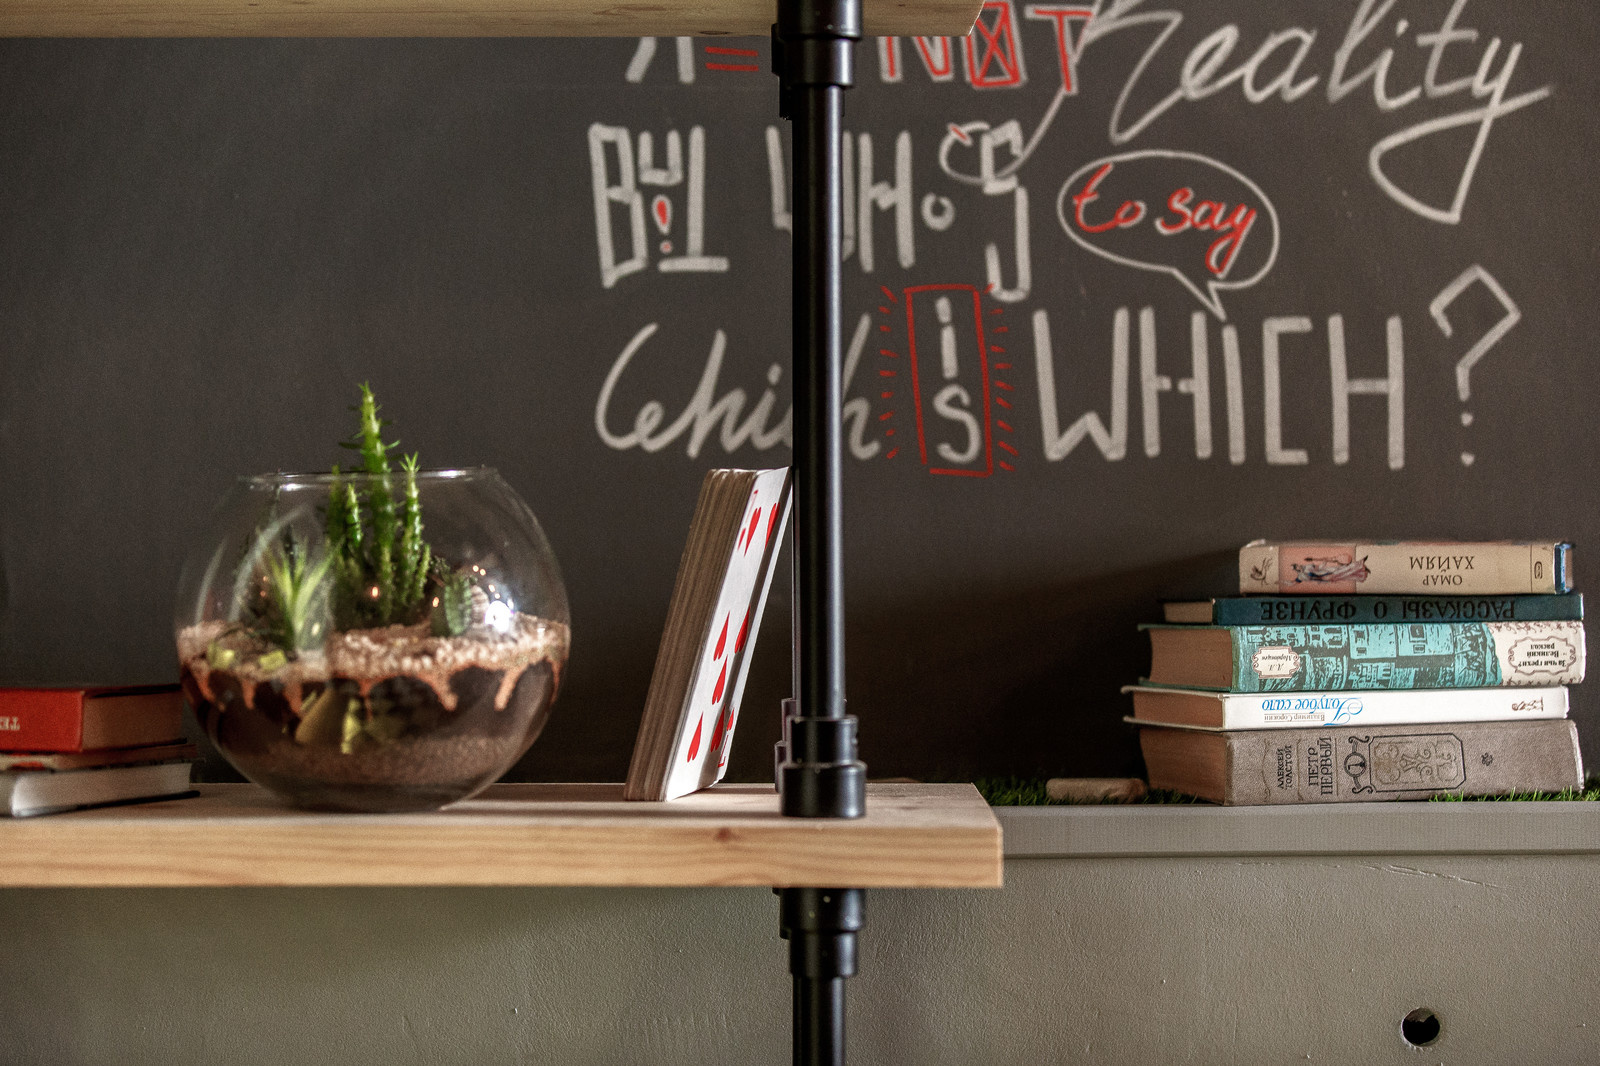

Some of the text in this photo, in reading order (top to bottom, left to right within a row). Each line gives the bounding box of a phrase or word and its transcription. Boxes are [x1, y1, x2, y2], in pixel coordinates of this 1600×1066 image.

[1072, 161, 1259, 279] to say
[1409, 556, 1475, 573] ХАЙЯМ
[1422, 574, 1463, 586] ОМАР
[1260, 599, 1516, 620] РАССКАЗЫ О ФРУНЗЕ
[1261, 694, 1363, 726] Голубое сало
[1264, 713, 1325, 722] Владимир Сорокин
[1276, 748, 1284, 789] АЛЕКСЕЙ
[1284, 745, 1293, 790] ТОЛСТОЙ
[1307, 747, 1318, 786] ПЕТР
[1317, 737, 1333, 795] ПЕРВЫЙ
